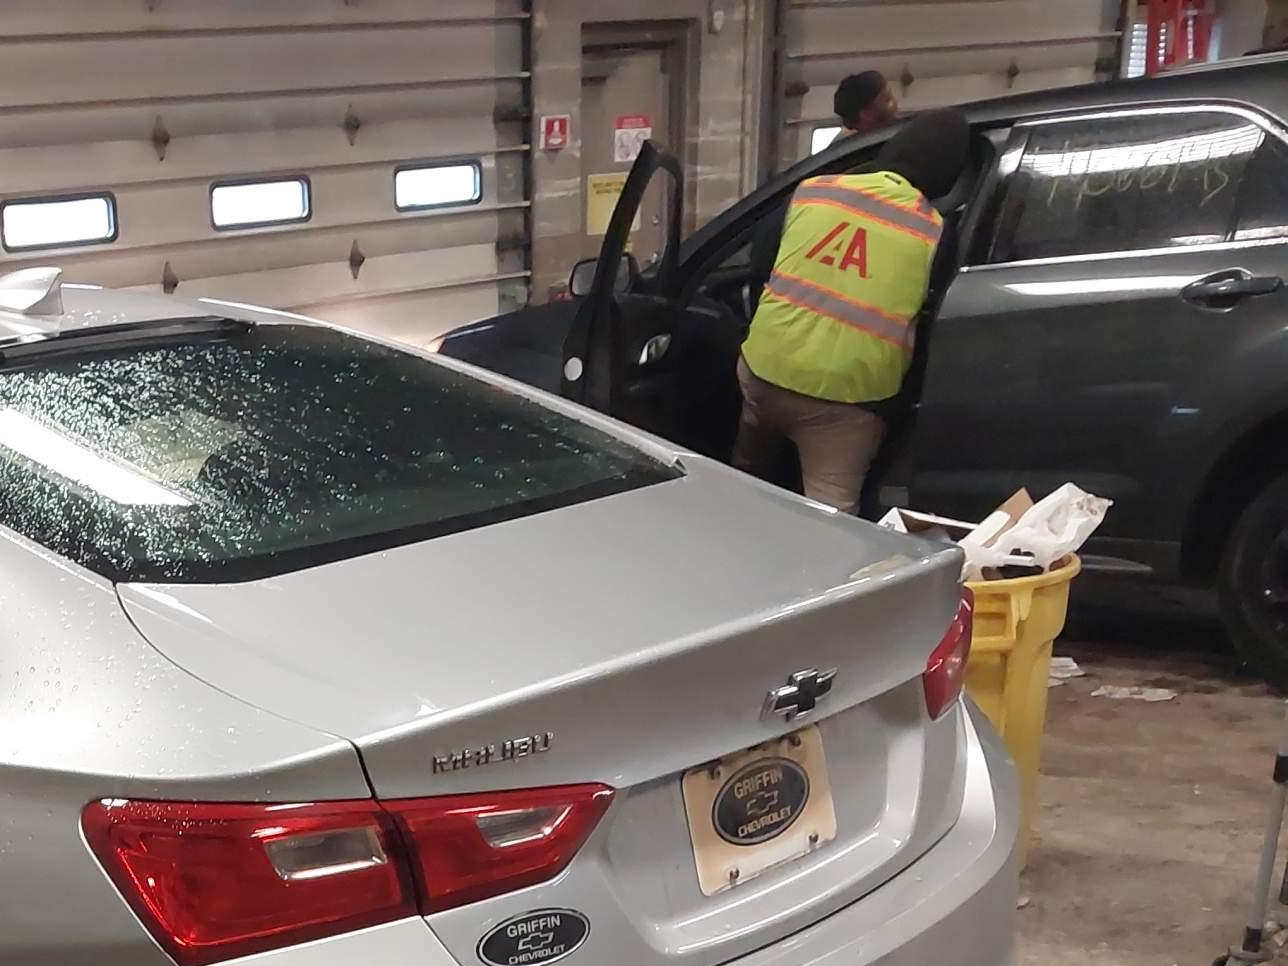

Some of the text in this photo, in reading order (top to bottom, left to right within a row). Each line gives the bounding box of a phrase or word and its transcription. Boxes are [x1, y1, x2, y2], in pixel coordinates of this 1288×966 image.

[734, 767, 783, 799] GRIFFIN
[737, 806, 792, 837] CHEVROLET
[506, 914, 561, 938] GRIFFIN
[508, 944, 566, 965] CHEVROLET
